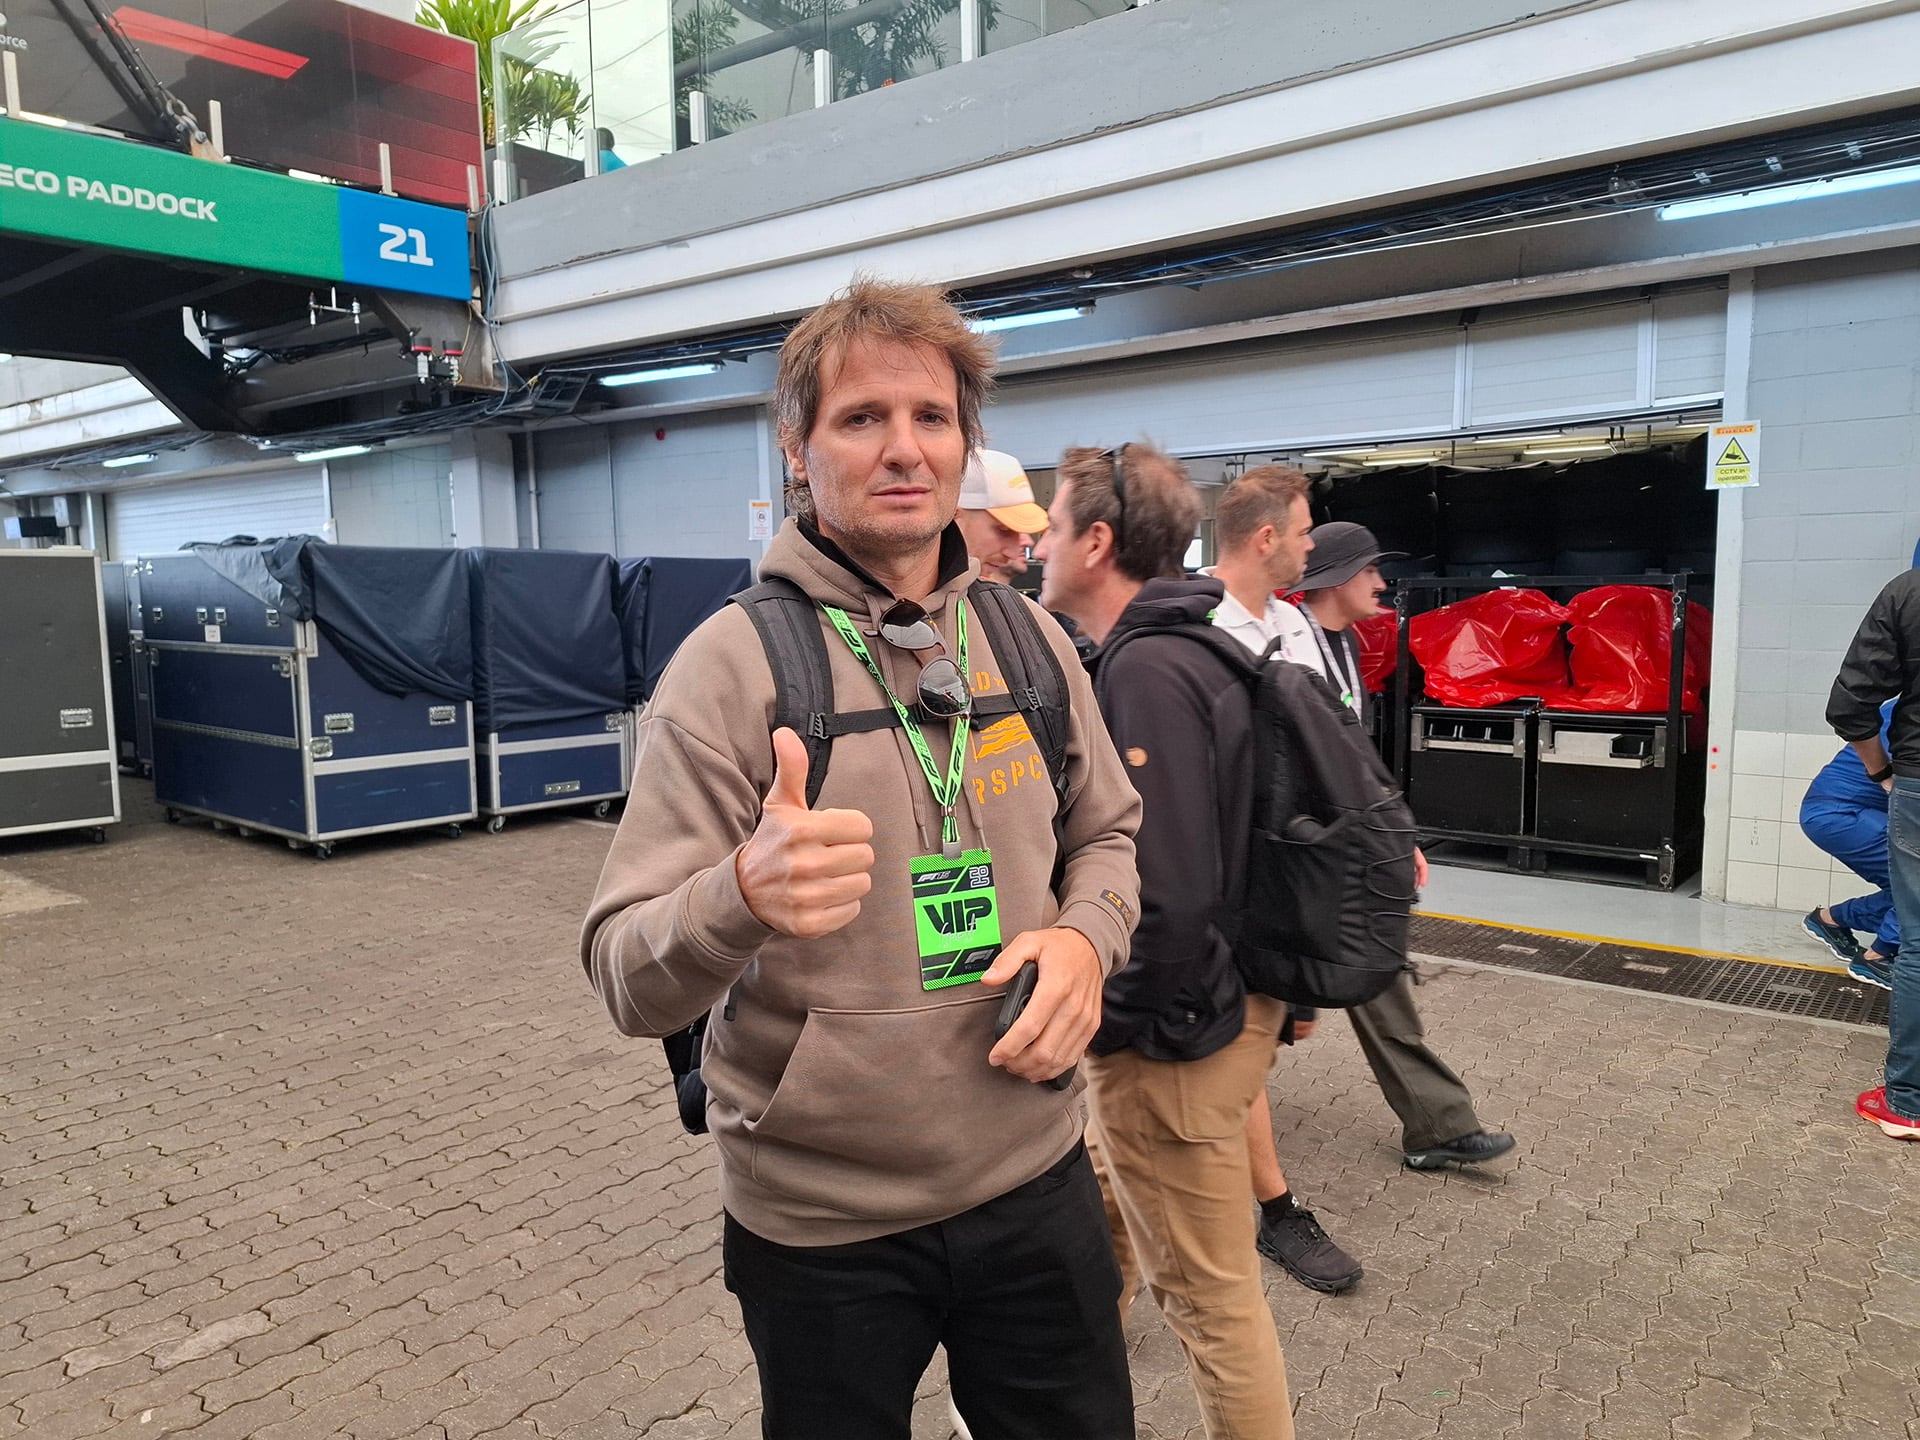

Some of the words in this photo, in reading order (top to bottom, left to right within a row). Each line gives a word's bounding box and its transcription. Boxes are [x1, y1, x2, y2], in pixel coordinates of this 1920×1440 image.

[67, 175, 218, 222] PADDOCK
[379, 223, 434, 266] 21
[922, 896, 993, 935] VIP
